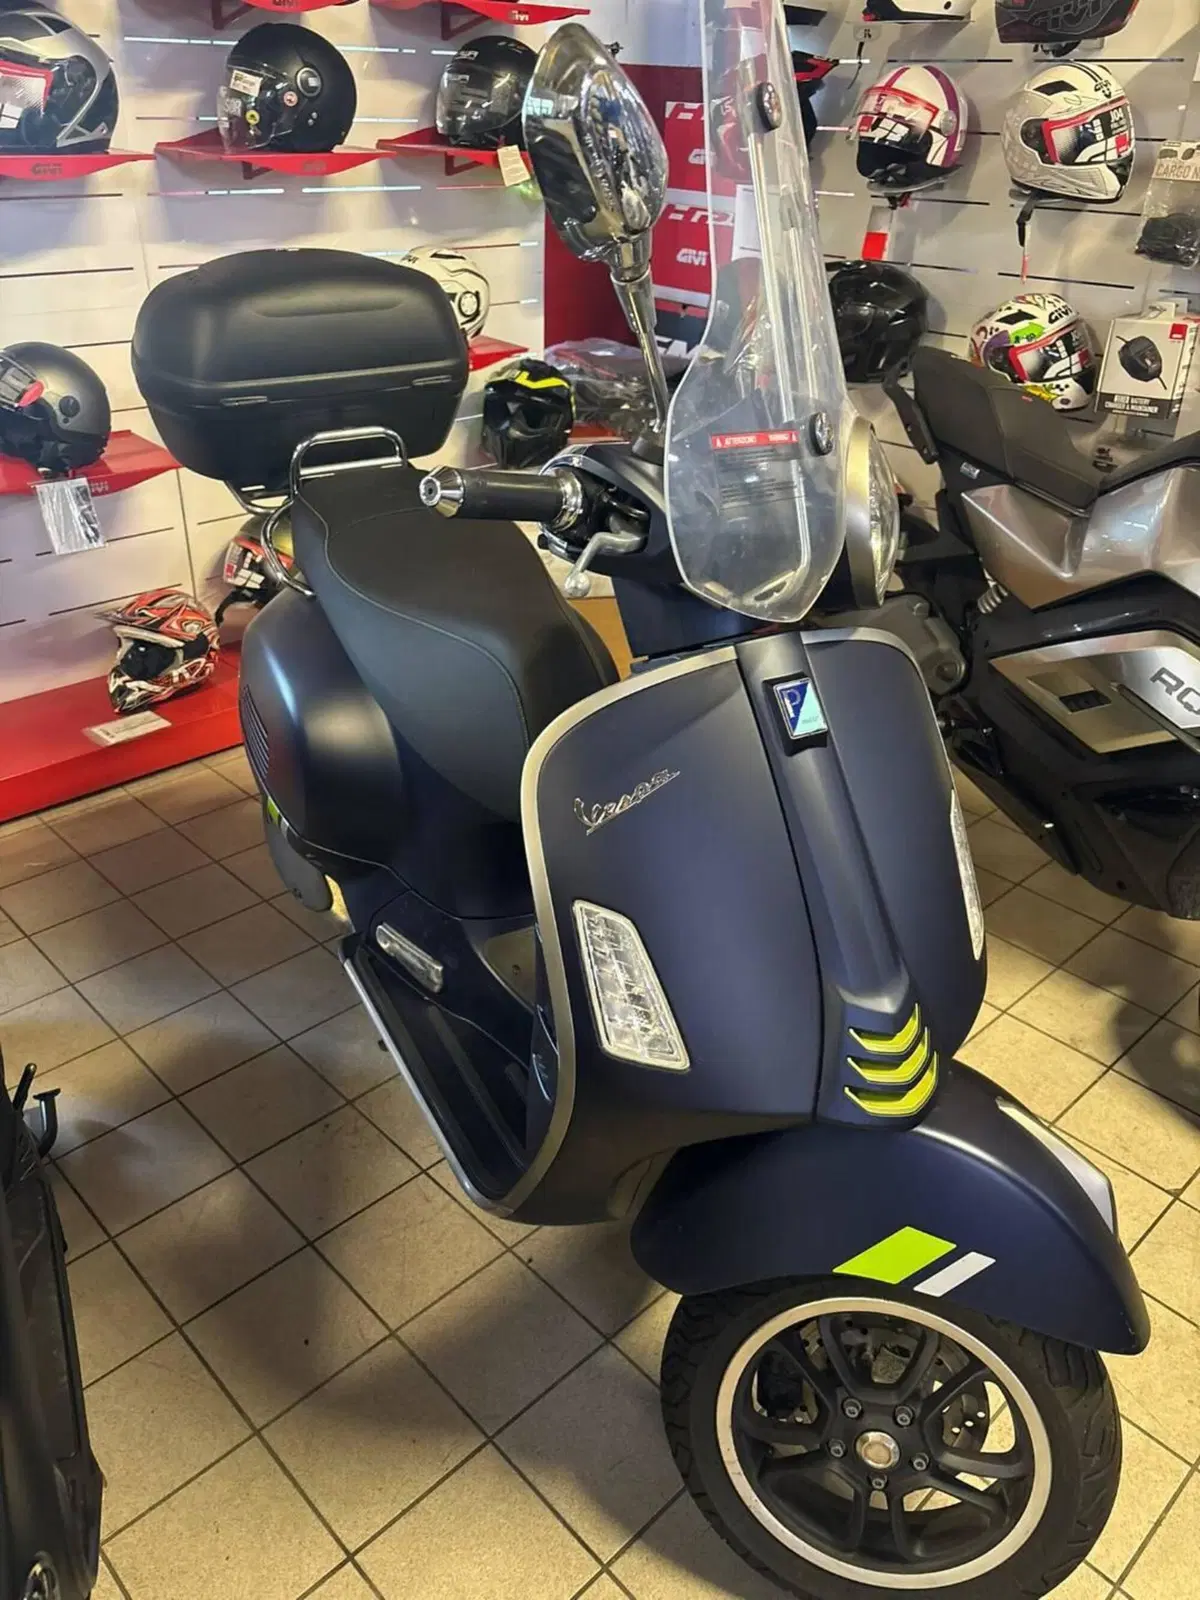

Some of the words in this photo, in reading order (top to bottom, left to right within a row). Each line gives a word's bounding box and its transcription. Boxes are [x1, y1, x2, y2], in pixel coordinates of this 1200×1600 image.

[1155, 163, 1191, 179] CARGO
[676, 248, 708, 267] GIVI
[1048, 304, 1073, 325] GIVI
[574, 767, 681, 836] Vespa
